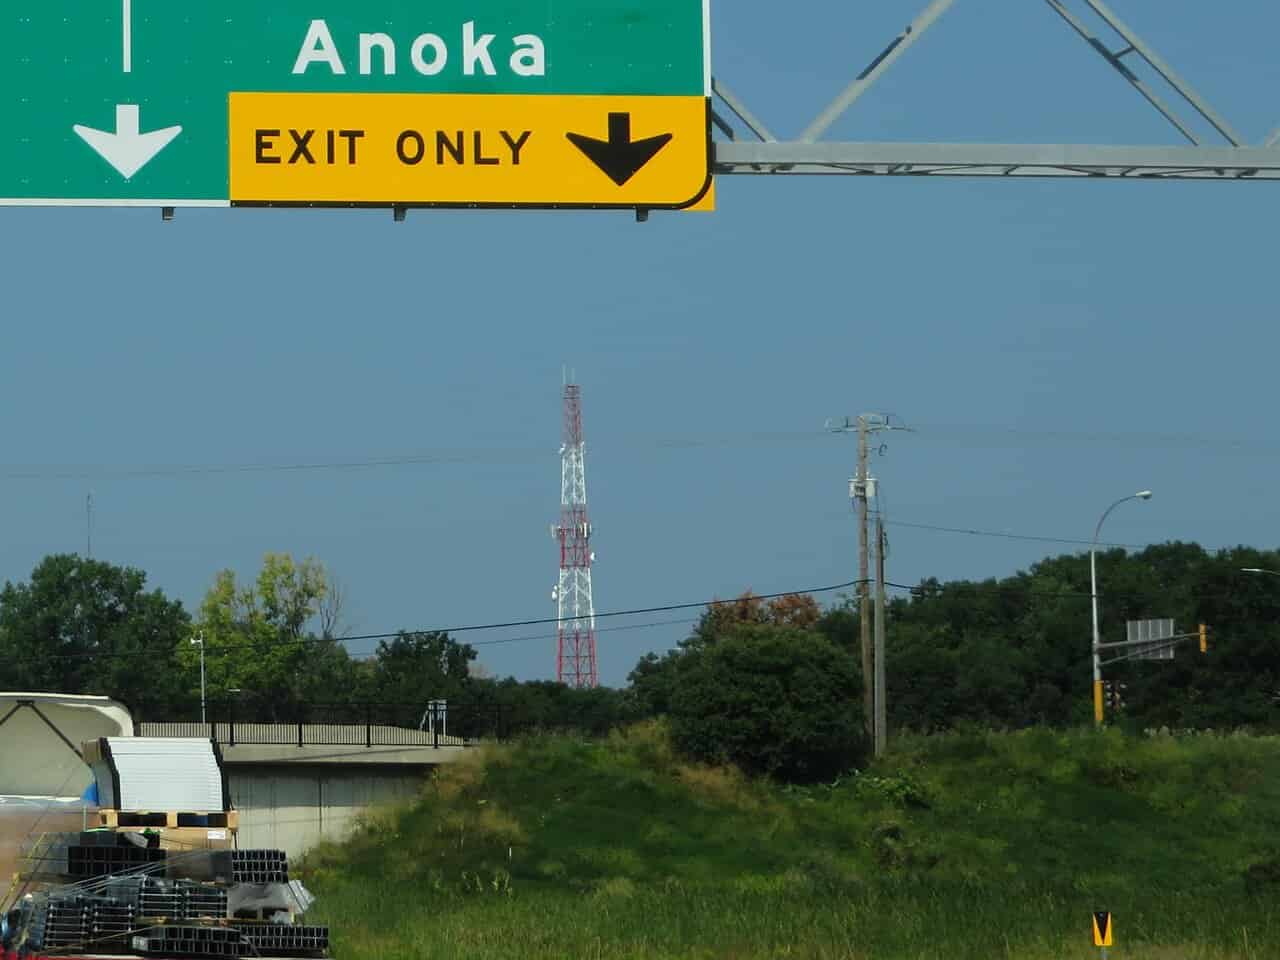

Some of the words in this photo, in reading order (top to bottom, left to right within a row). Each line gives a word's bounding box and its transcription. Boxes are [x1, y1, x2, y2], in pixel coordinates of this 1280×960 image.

[292, 19, 546, 77] Anoka
[256, 129, 365, 164] EXIT
[396, 129, 531, 166] ONLY
